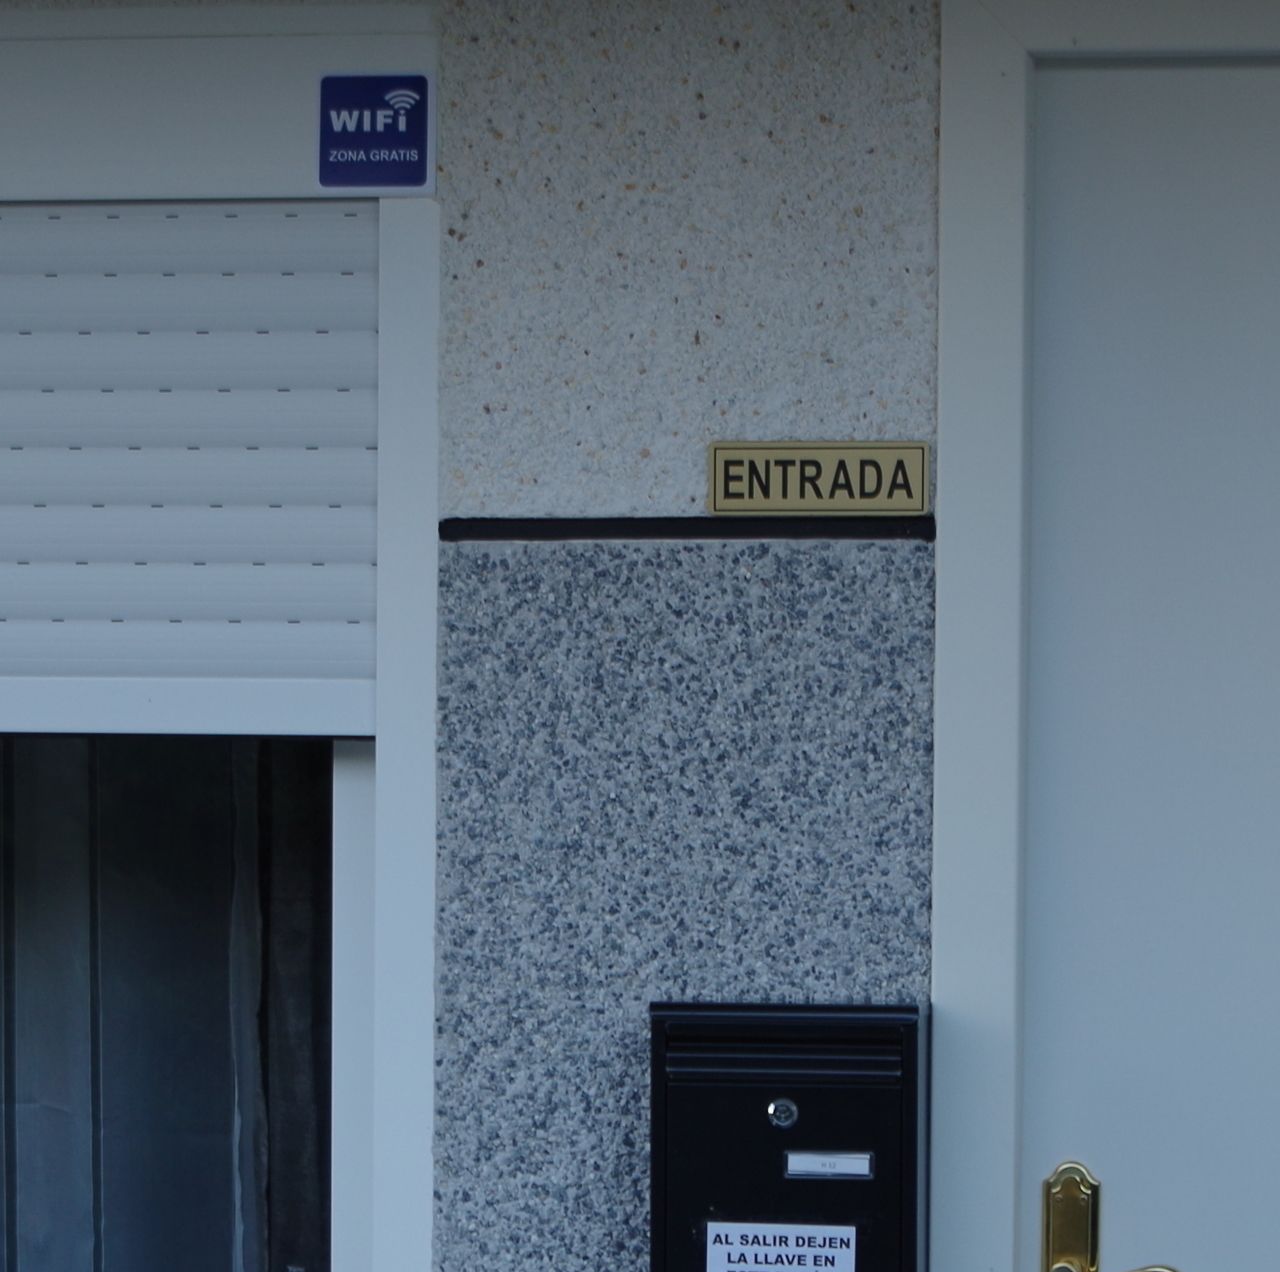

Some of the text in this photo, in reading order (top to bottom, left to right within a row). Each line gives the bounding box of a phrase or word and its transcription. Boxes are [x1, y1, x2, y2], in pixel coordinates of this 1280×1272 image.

[329, 149, 419, 162] ZONA GRATIS
[723, 459, 914, 500] ENTRADA
[712, 1233, 851, 1249] AL SALIR DEJEN
[727, 1252, 835, 1268] LA LLAVE EN
